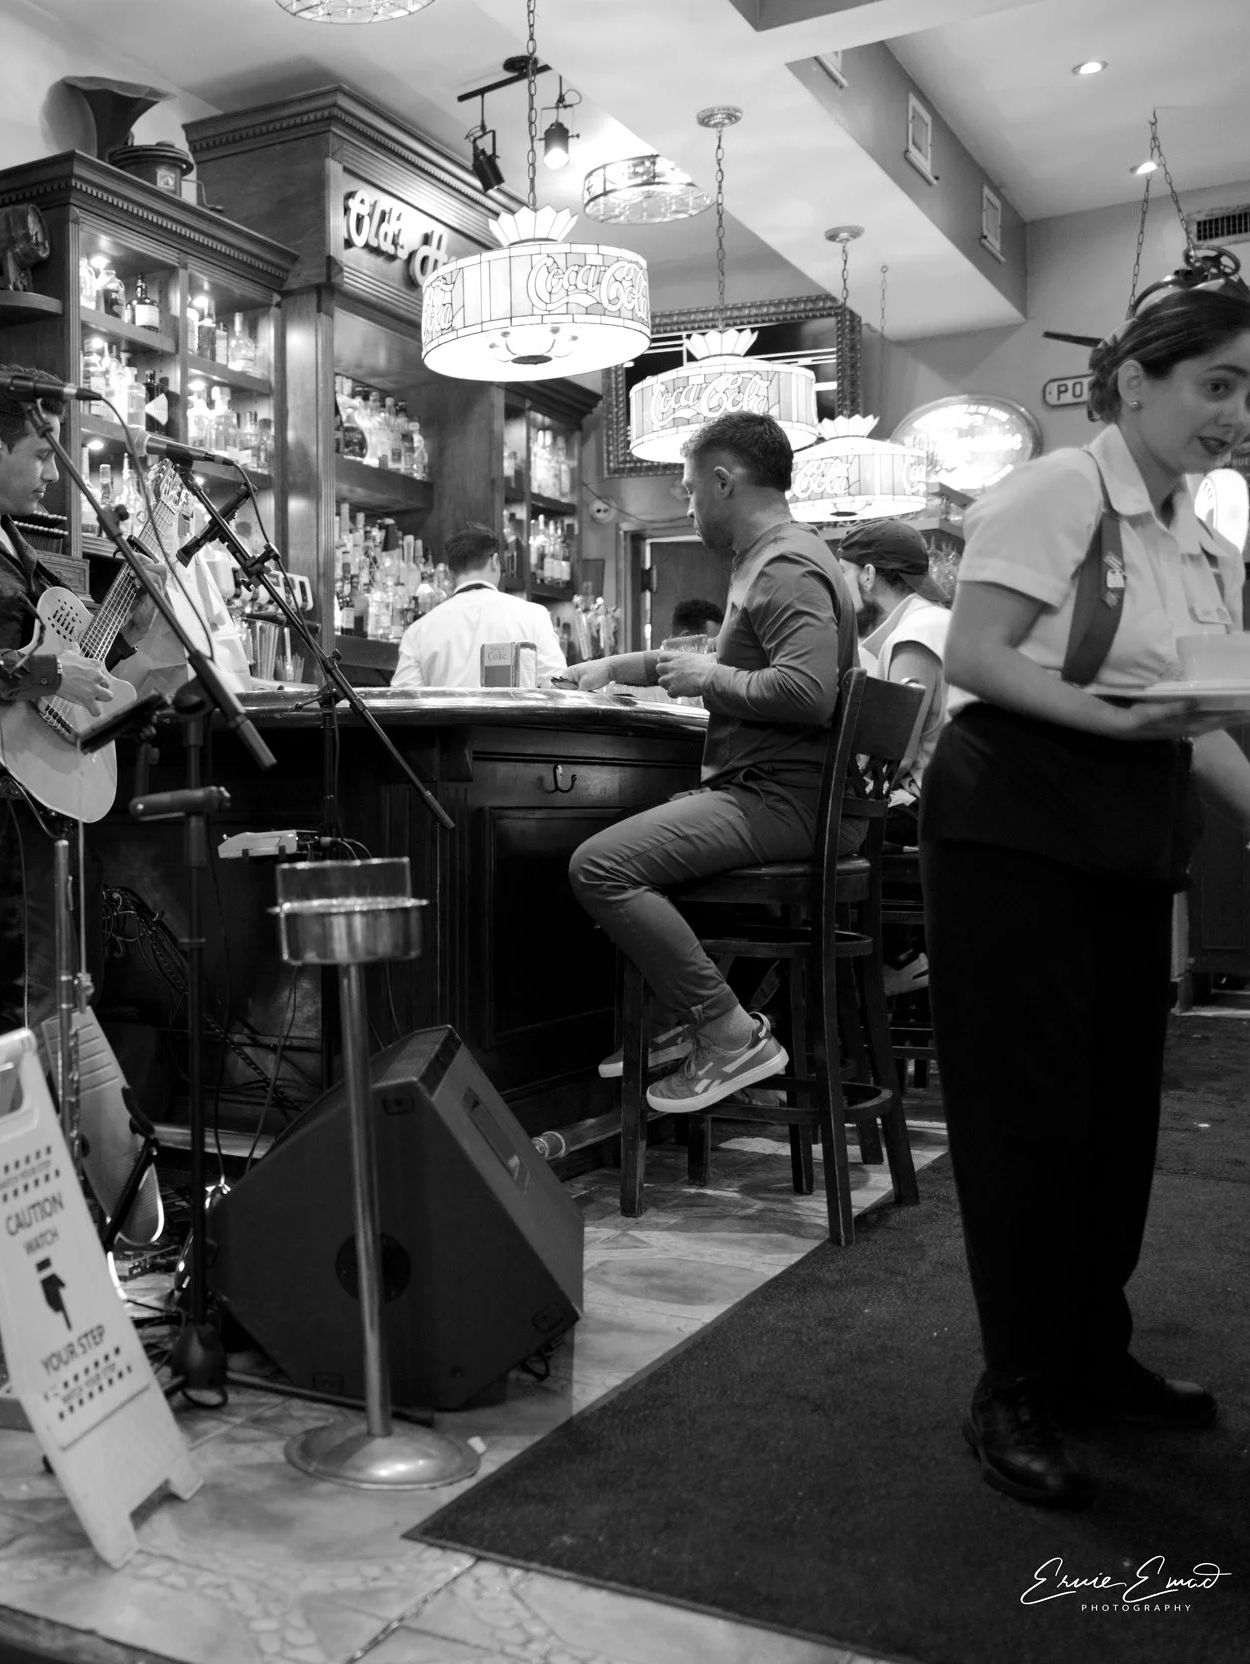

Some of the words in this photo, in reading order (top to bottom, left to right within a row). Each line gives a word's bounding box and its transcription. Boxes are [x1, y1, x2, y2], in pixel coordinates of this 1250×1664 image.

[6, 1192, 64, 1236] CAUTION
[23, 1227, 60, 1256] WATCH
[41, 1341, 78, 1377] YOUR
[77, 1324, 105, 1355] STEP
